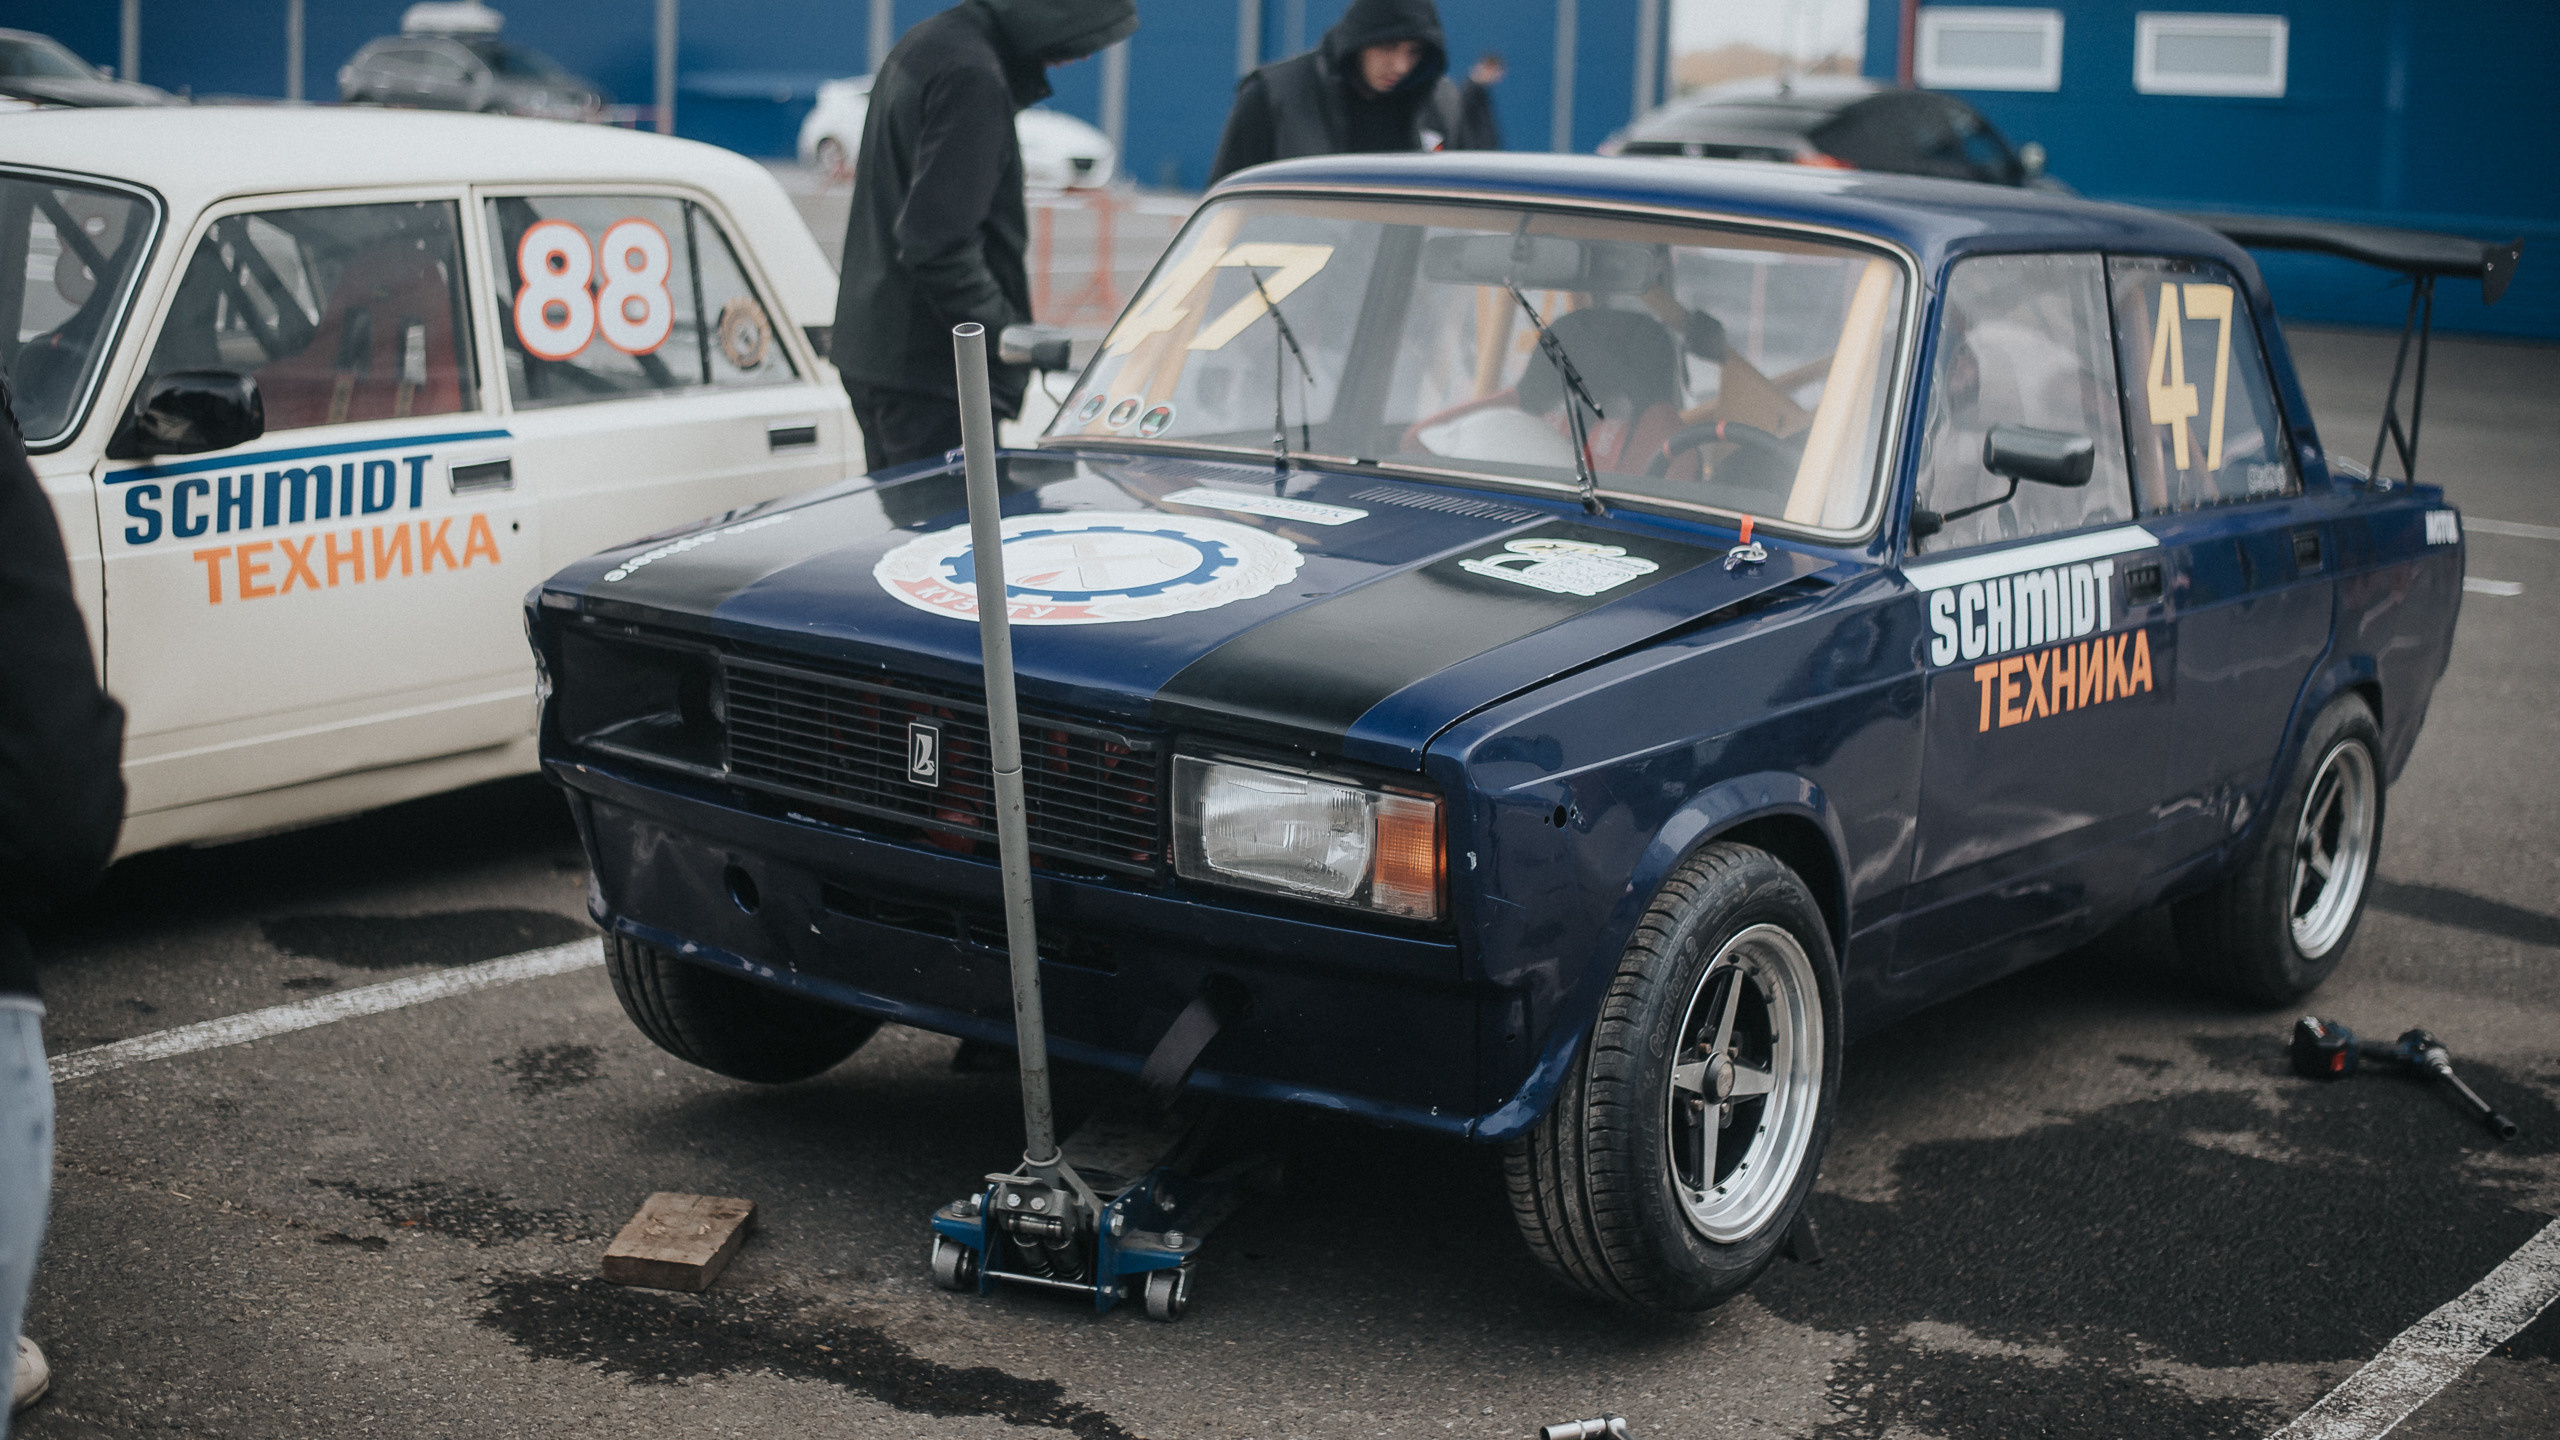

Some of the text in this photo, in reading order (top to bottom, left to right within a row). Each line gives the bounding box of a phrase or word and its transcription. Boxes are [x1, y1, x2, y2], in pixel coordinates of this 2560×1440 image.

[513, 216, 674, 362] 88
[1102, 242, 1335, 358] 47
[2147, 282, 2234, 471] 47
[193, 513, 501, 605] ТЕХНИКА
[914, 585, 1056, 619] КУЗТУ
[1974, 628, 2153, 733] ТЕХНИКА
